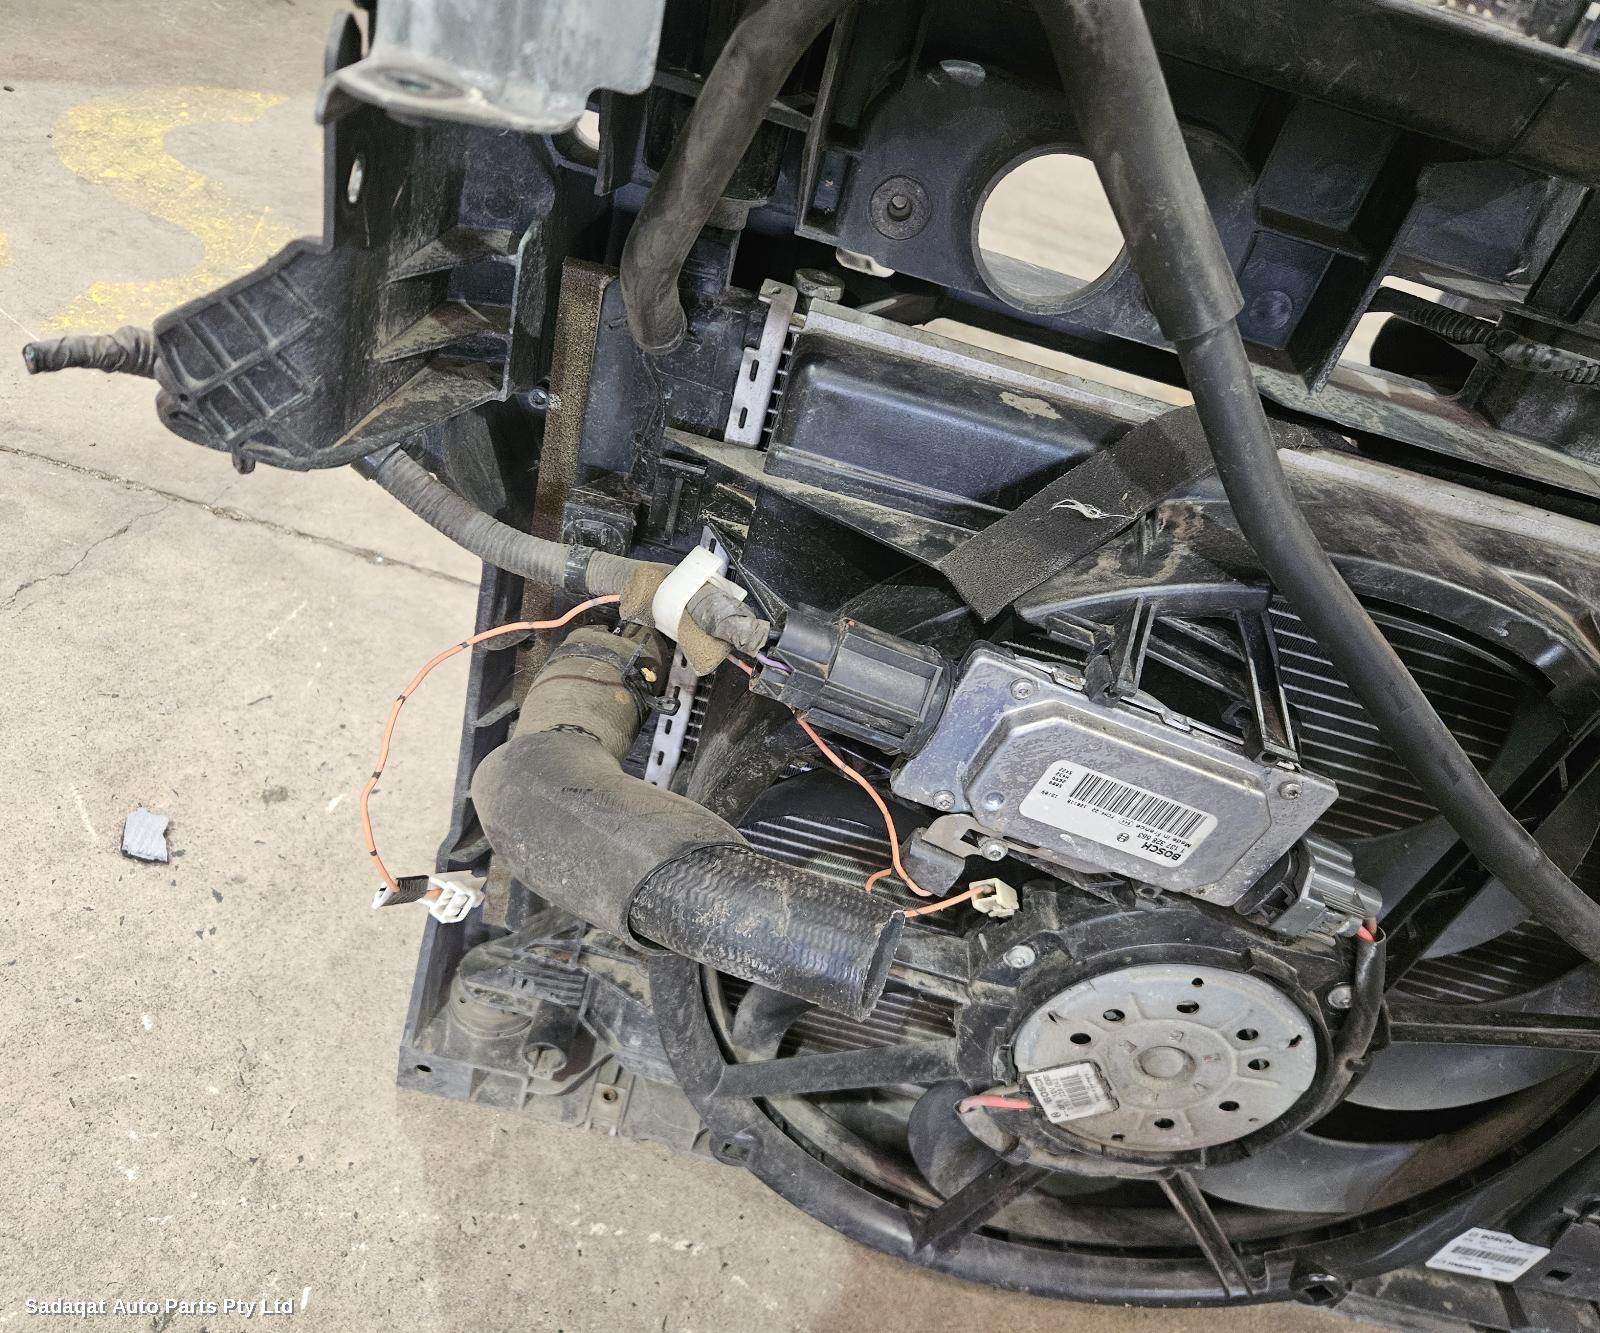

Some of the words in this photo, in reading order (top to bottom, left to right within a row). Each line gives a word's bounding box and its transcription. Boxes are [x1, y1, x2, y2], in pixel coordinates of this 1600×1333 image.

[1133, 823, 1162, 837] France
[1150, 836, 1166, 846] 328
[1170, 836, 1192, 848] Made
[1140, 841, 1182, 861] BOSCH
[1031, 1076, 1053, 1104] BOSCH
[1480, 1234, 1514, 1244] BOSCH
